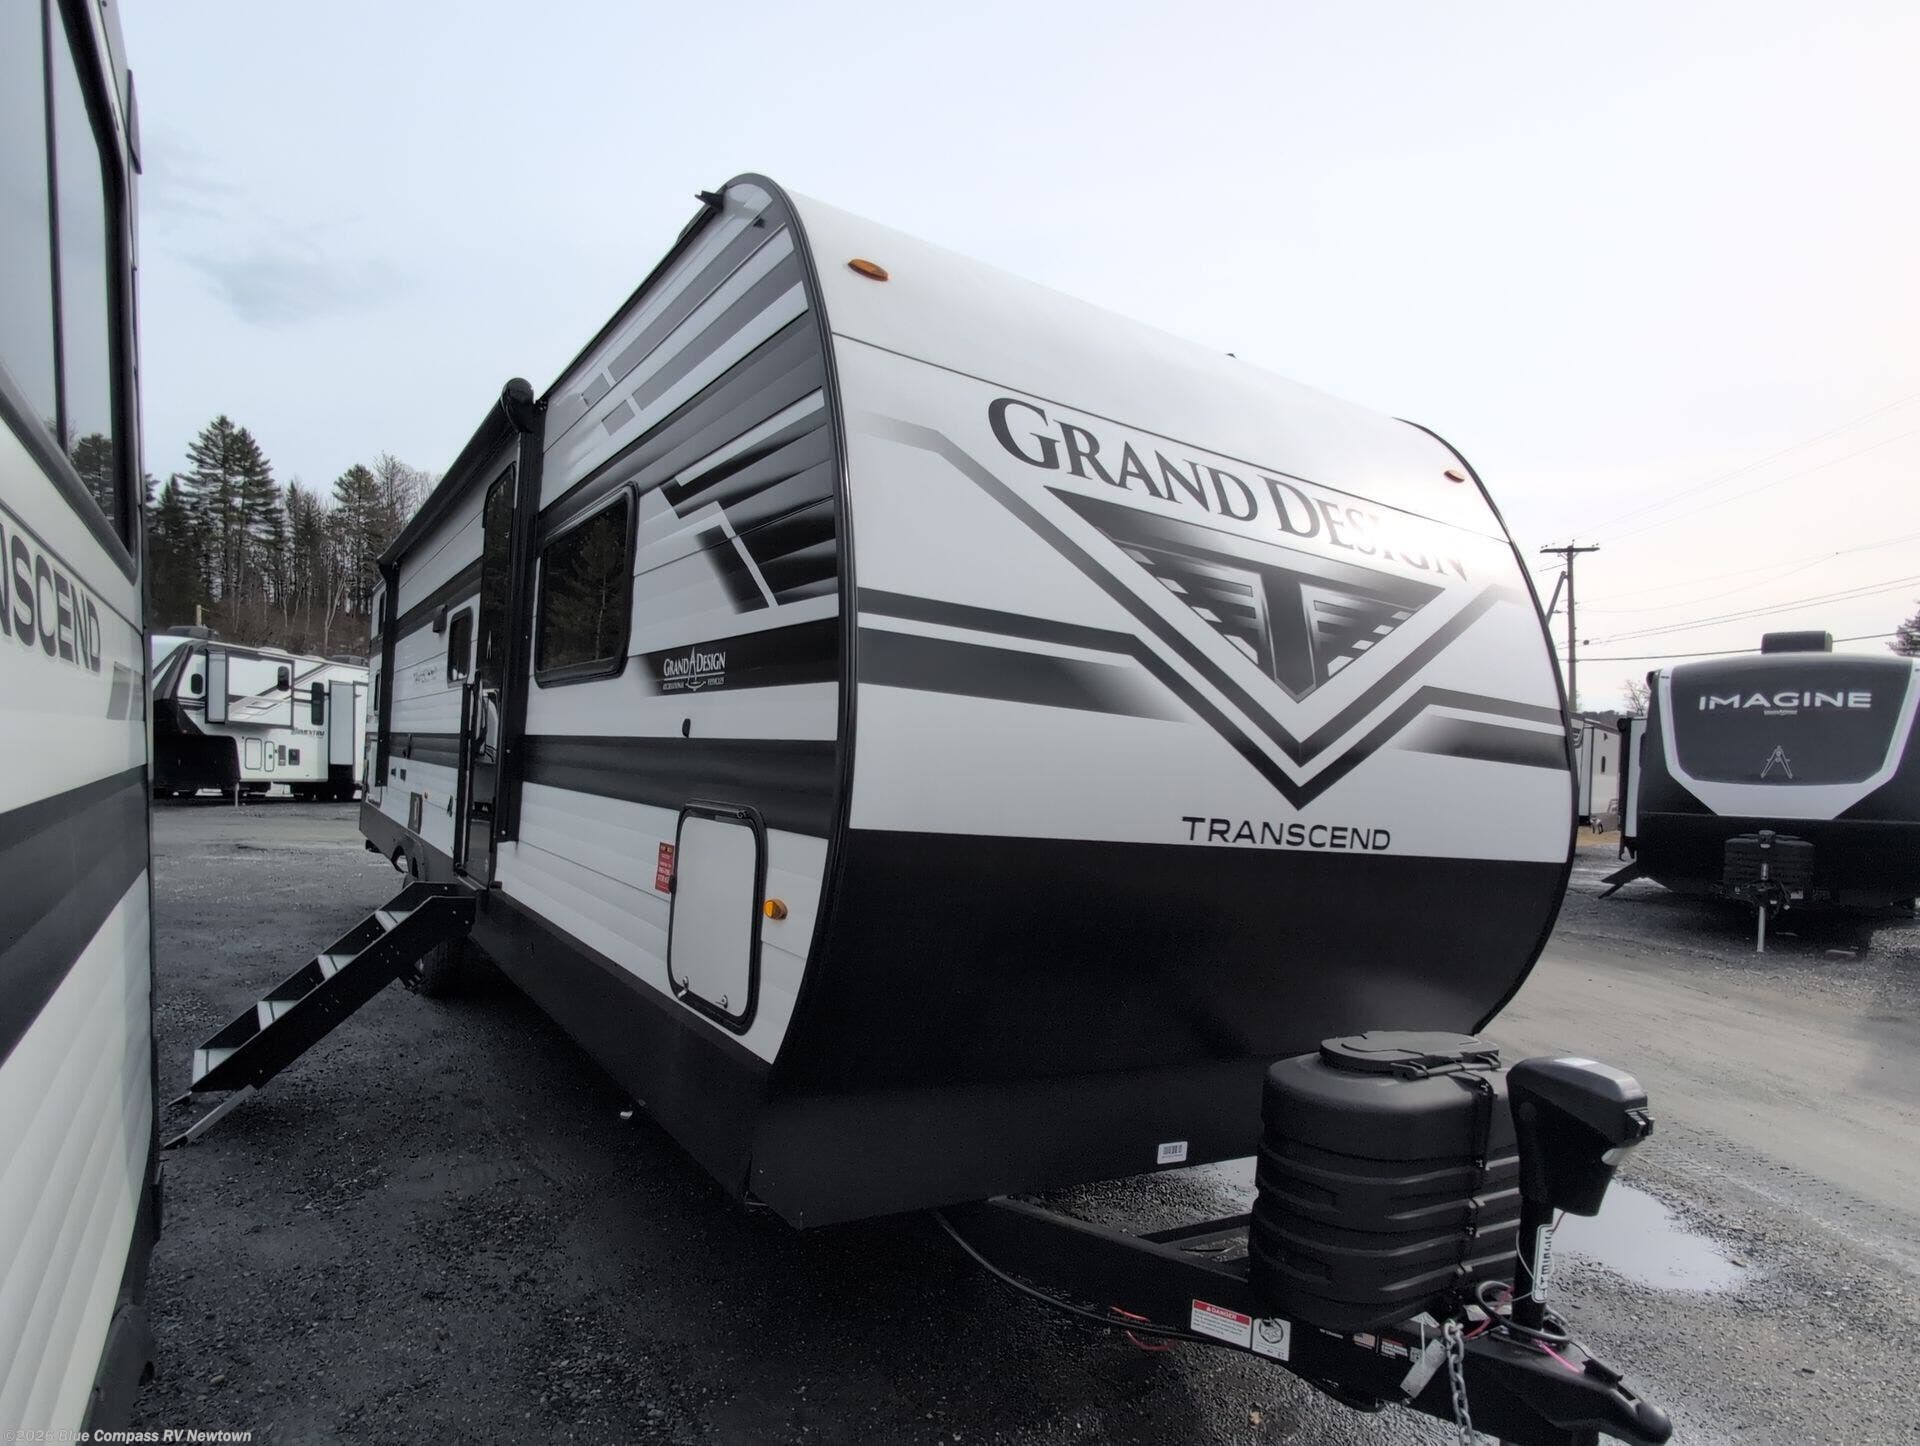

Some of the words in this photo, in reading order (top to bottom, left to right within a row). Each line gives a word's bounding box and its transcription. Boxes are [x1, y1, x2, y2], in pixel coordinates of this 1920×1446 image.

[987, 397, 1260, 523] GRAND
[1257, 474, 1468, 583] DES
[663, 658, 689, 677] GRAND
[696, 651, 726, 673] DESIGN
[1698, 691, 1872, 711] IMAGINE
[1181, 816, 1391, 851] TRANSCEND
